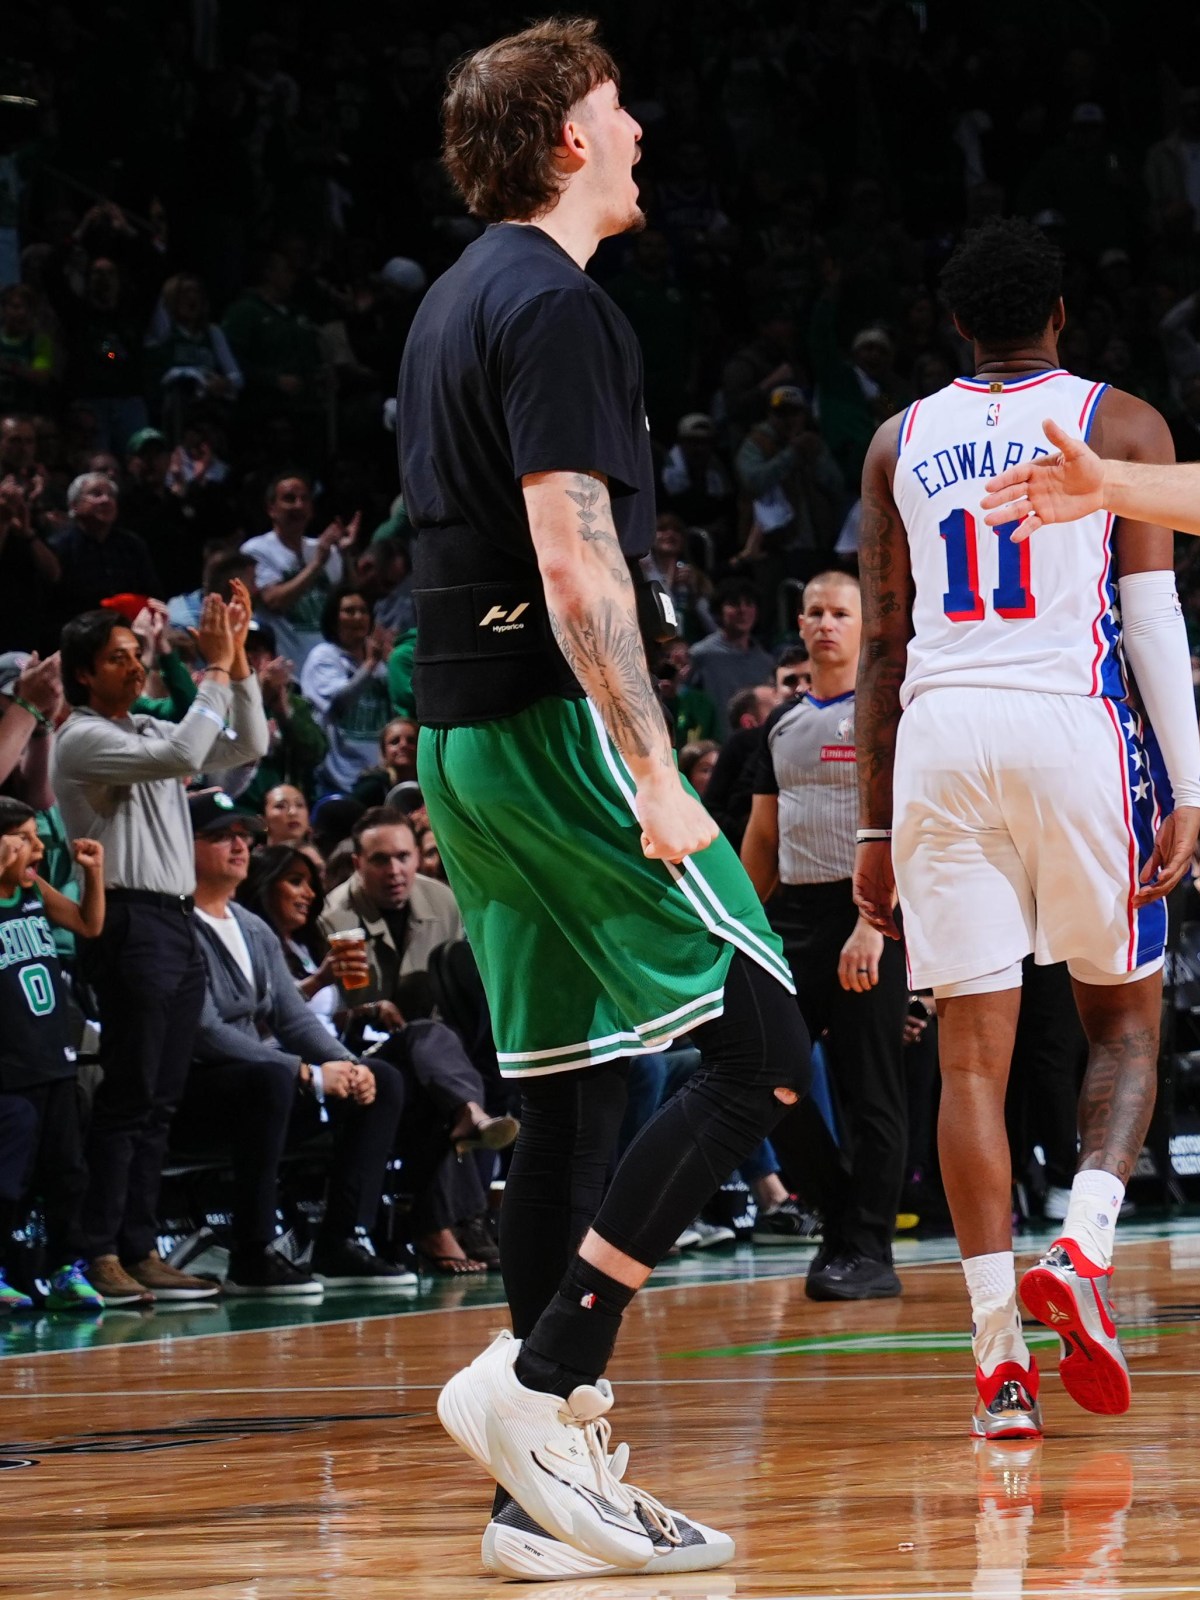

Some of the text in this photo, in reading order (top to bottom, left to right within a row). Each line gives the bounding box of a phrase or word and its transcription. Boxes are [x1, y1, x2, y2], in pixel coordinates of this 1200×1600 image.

[939, 508, 1036, 623] 11
[492, 623, 525, 633] Hyperice
[18, 963, 56, 1017] 0
